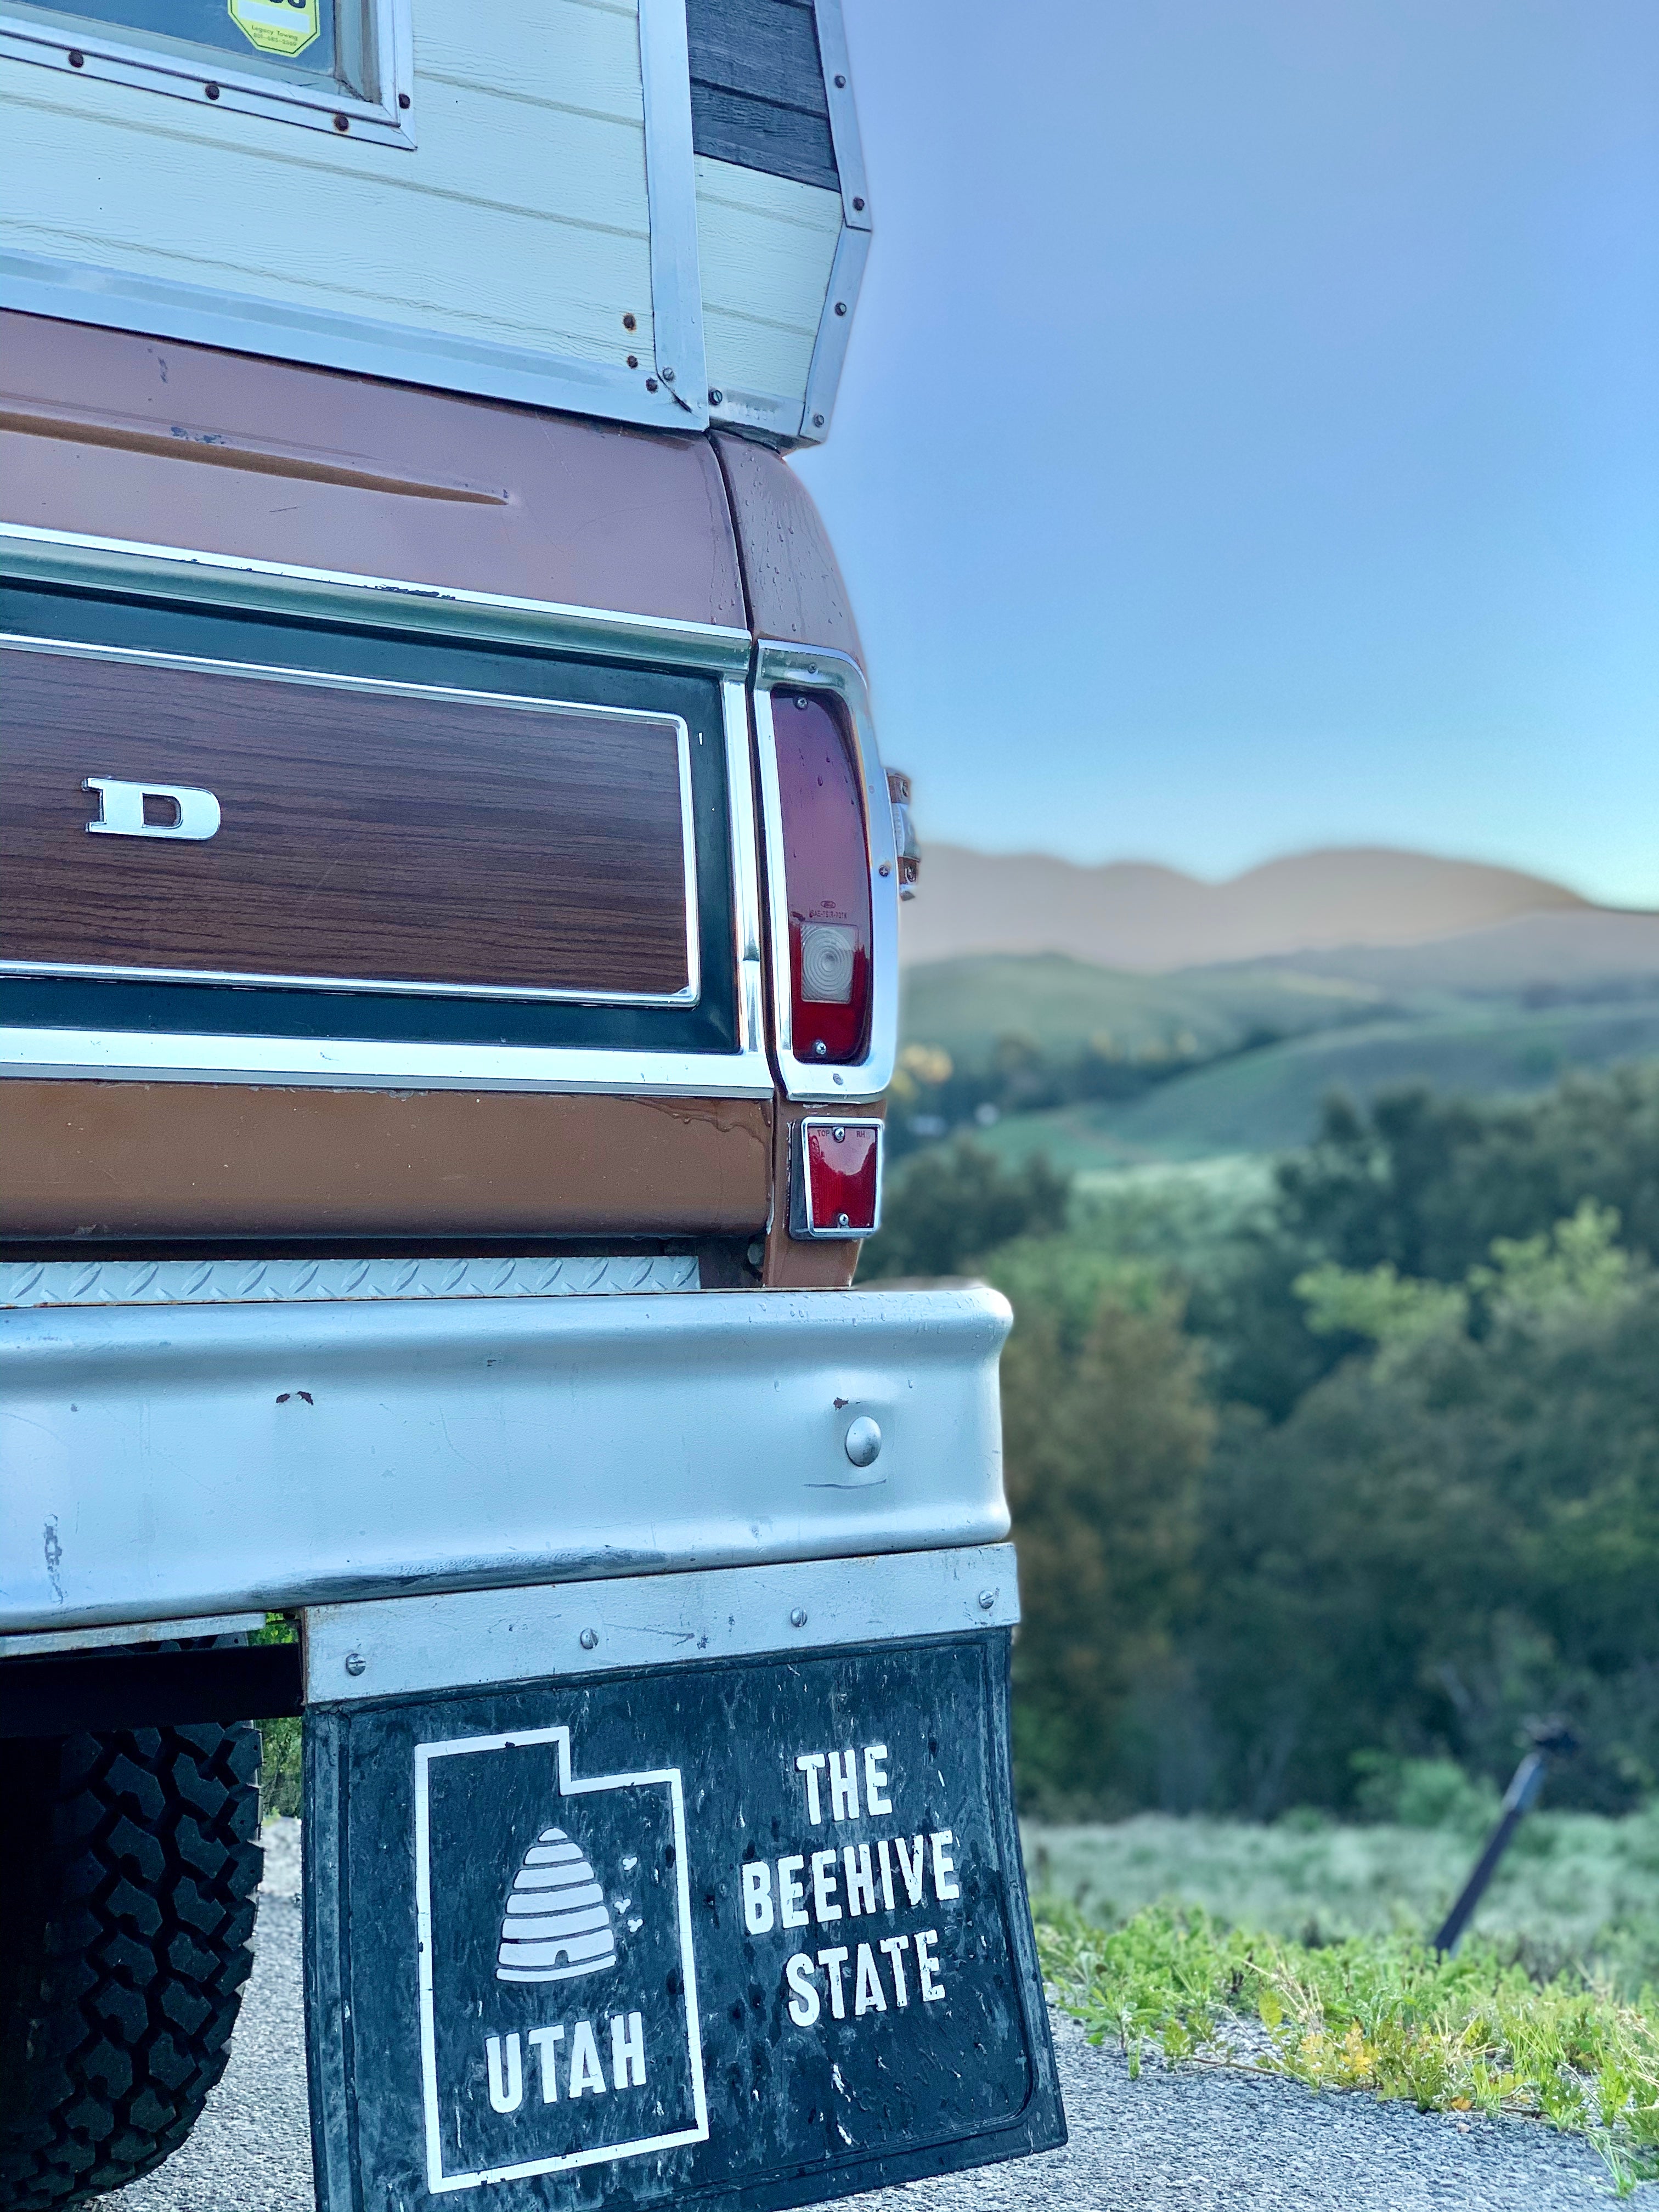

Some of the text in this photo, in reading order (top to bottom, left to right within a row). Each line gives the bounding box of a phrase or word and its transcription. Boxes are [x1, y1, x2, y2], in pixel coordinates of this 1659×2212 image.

[252, 25, 274, 35] Legacy
[82, 777, 221, 840] D
[795, 1745, 893, 1825] THE
[742, 1830, 960, 1935] BEEHIVE
[786, 1929, 945, 2027] STATE
[486, 2011, 646, 2113] UTAH
